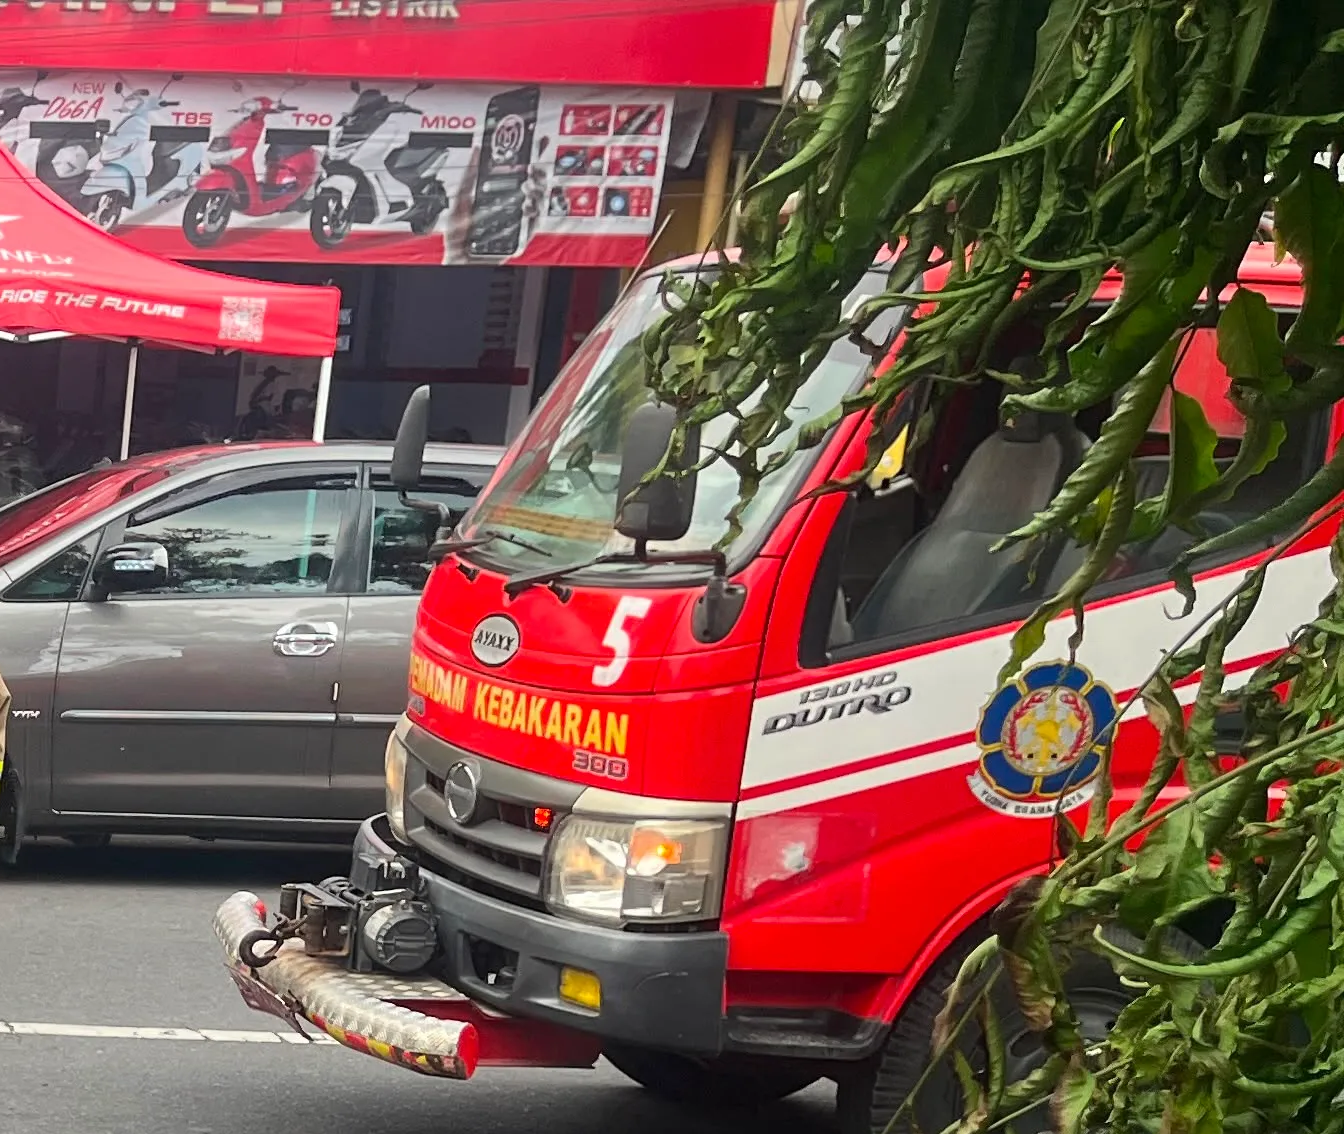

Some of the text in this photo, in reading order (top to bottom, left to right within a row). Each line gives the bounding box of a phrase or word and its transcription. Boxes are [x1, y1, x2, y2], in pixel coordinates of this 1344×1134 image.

[73, 81, 106, 95] NEW
[170, 110, 212, 126] T85
[292, 111, 333, 127] T90
[420, 114, 476, 130] M100
[0, 288, 187, 319] RIDE THE FUTURE
[473, 628, 516, 652] AYAXX
[591, 594, 653, 688] 5
[799, 670, 899, 705] 130 HD
[472, 681, 629, 756] KEBAKARAN
[761, 685, 912, 736] DUTRO
[573, 751, 628, 779] 300
